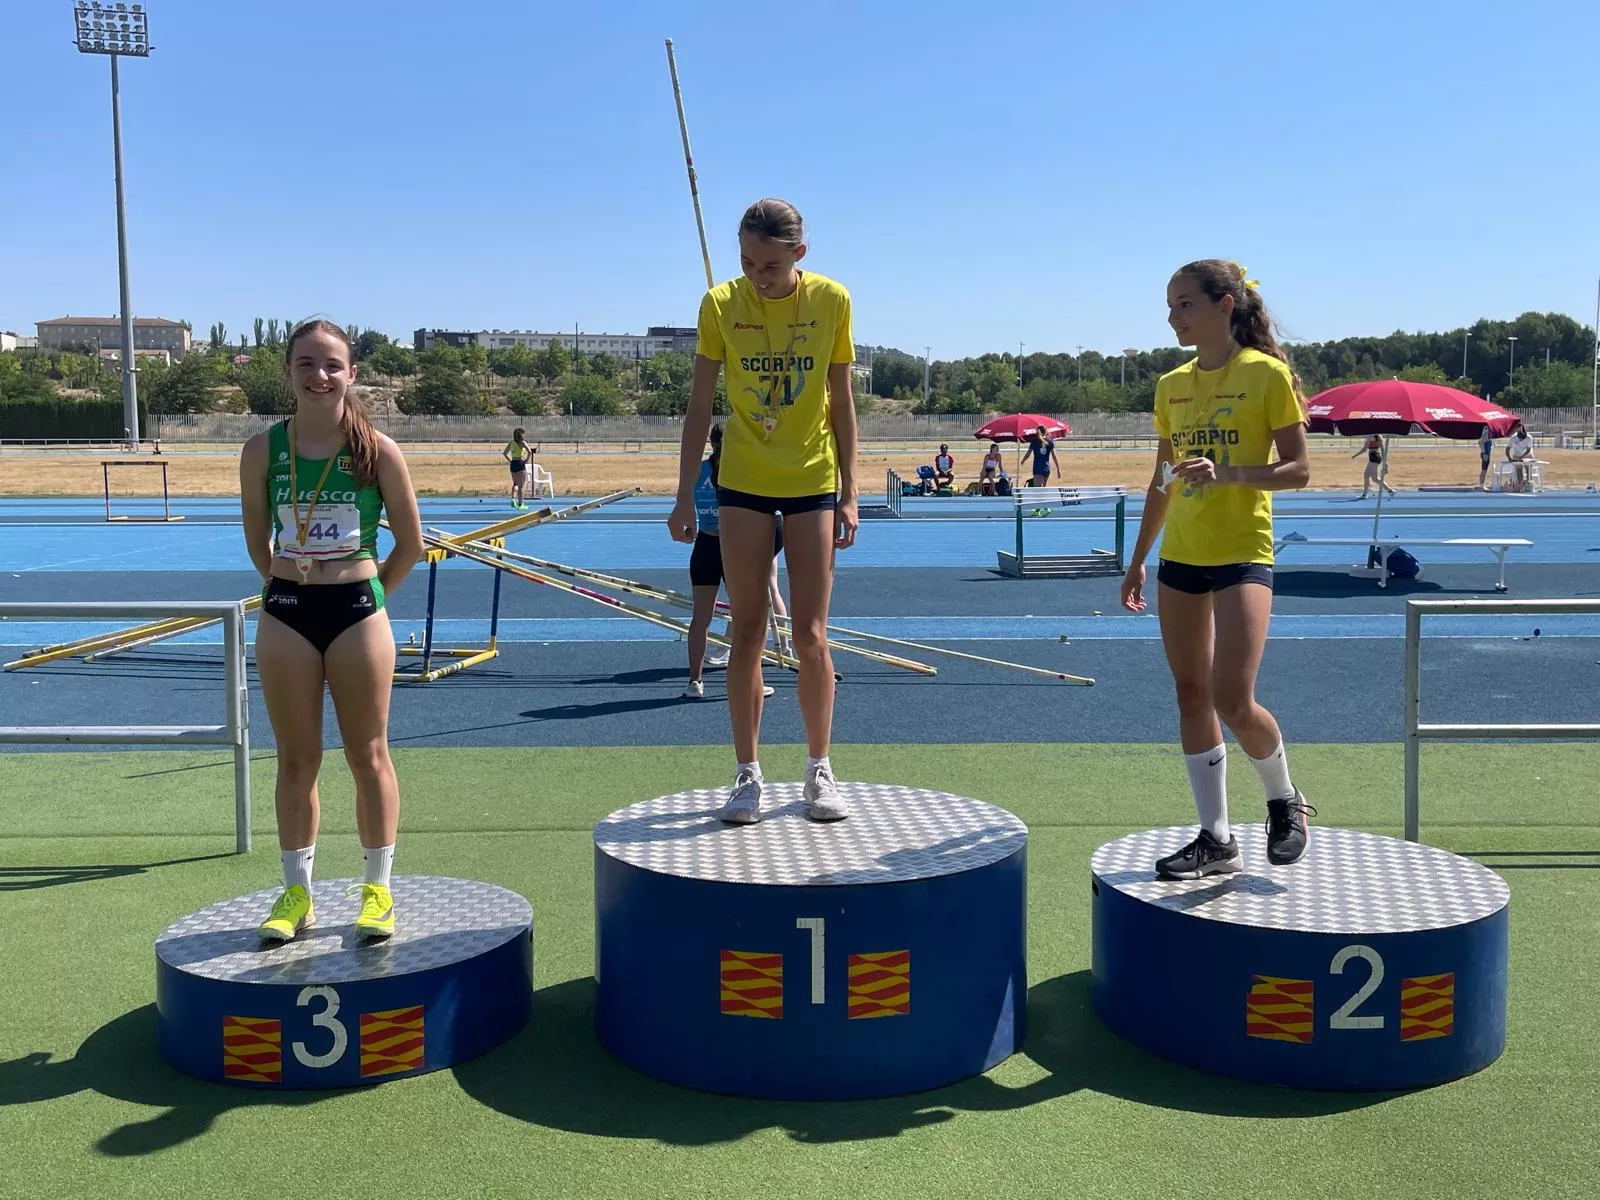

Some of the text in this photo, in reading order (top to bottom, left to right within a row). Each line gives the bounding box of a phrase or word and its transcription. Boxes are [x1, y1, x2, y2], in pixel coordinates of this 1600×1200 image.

[740, 356, 814, 372] SCORPIO
[796, 917, 825, 1004] 1
[1329, 944, 1385, 1029] 2
[292, 984, 348, 1069] 3
